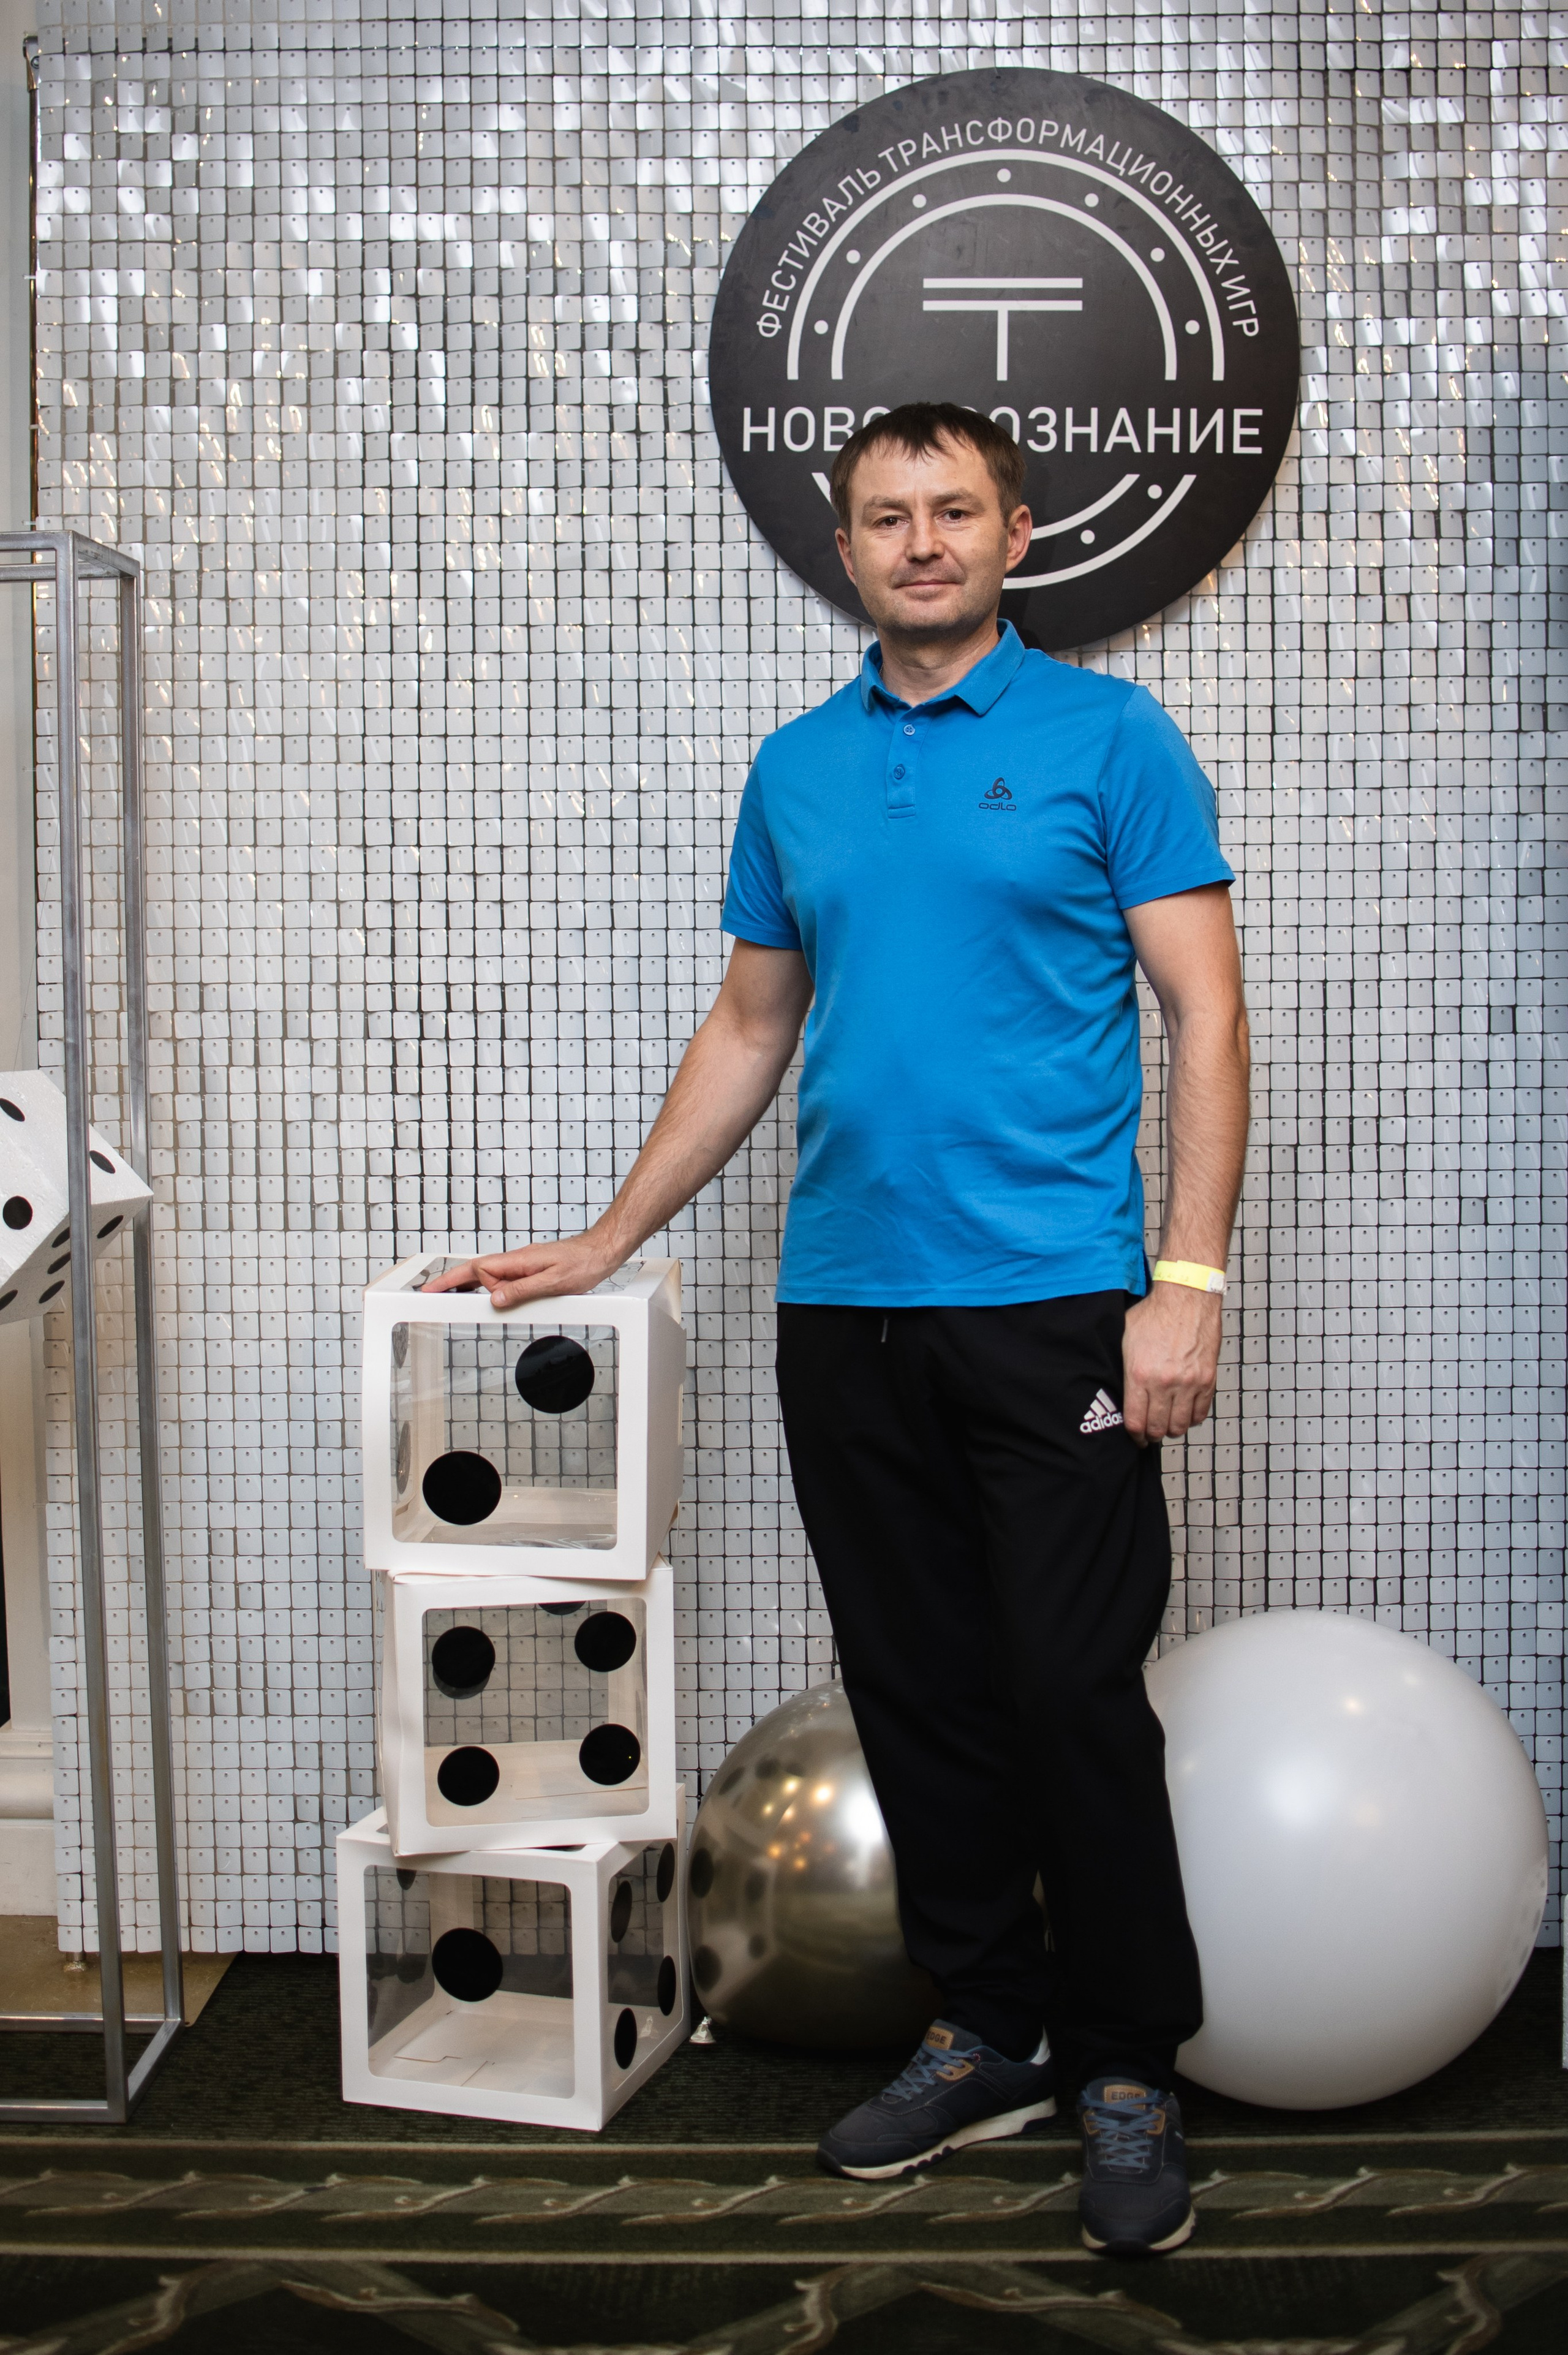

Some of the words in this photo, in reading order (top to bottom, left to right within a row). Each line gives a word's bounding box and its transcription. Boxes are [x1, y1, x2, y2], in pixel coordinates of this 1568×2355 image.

[756, 167, 881, 338] ФЕСТИВАЛЬ
[877, 116, 1240, 275] ТРАНСФОРМАЦИОННЫХ
[1221, 274, 1259, 337] ИГР
[959, 406, 1263, 454] ОЗНАНИЕ
[978, 801, 1017, 811] odlo
